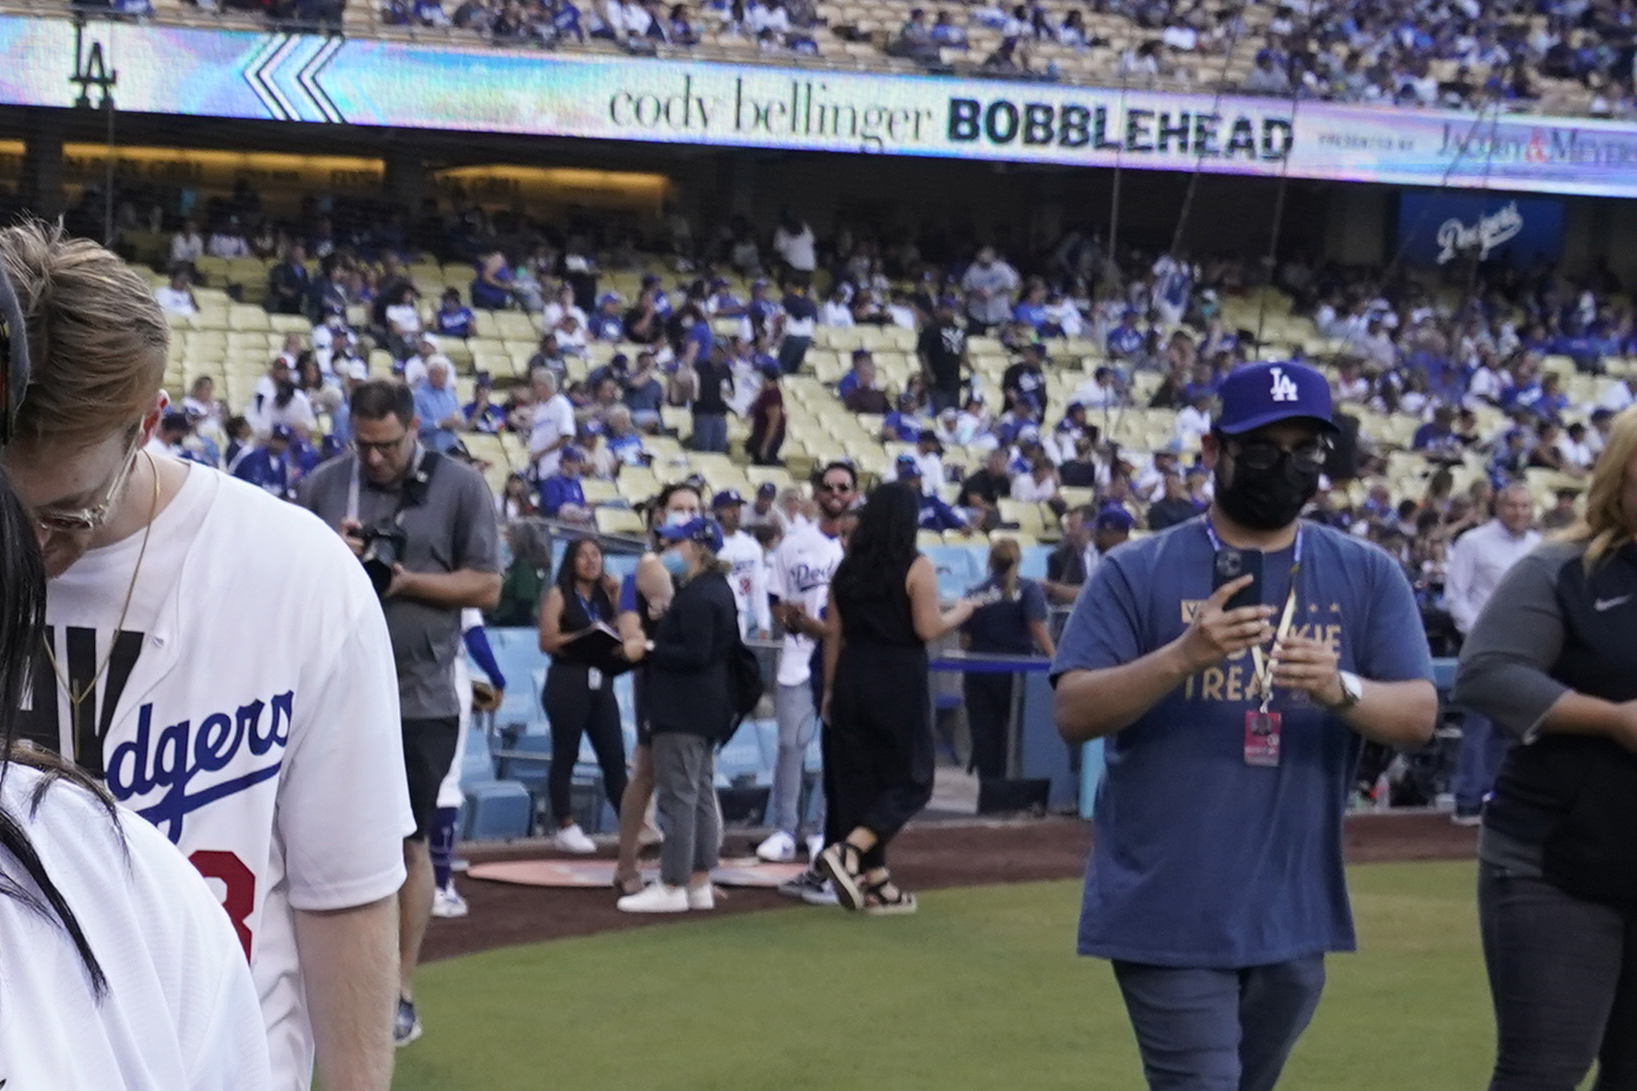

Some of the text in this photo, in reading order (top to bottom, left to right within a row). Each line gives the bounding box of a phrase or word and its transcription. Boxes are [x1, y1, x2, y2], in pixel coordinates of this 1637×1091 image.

[609, 74, 1294, 160] cody bellinger BOBBLEHEAD
[1269, 367, 1299, 402] LA
